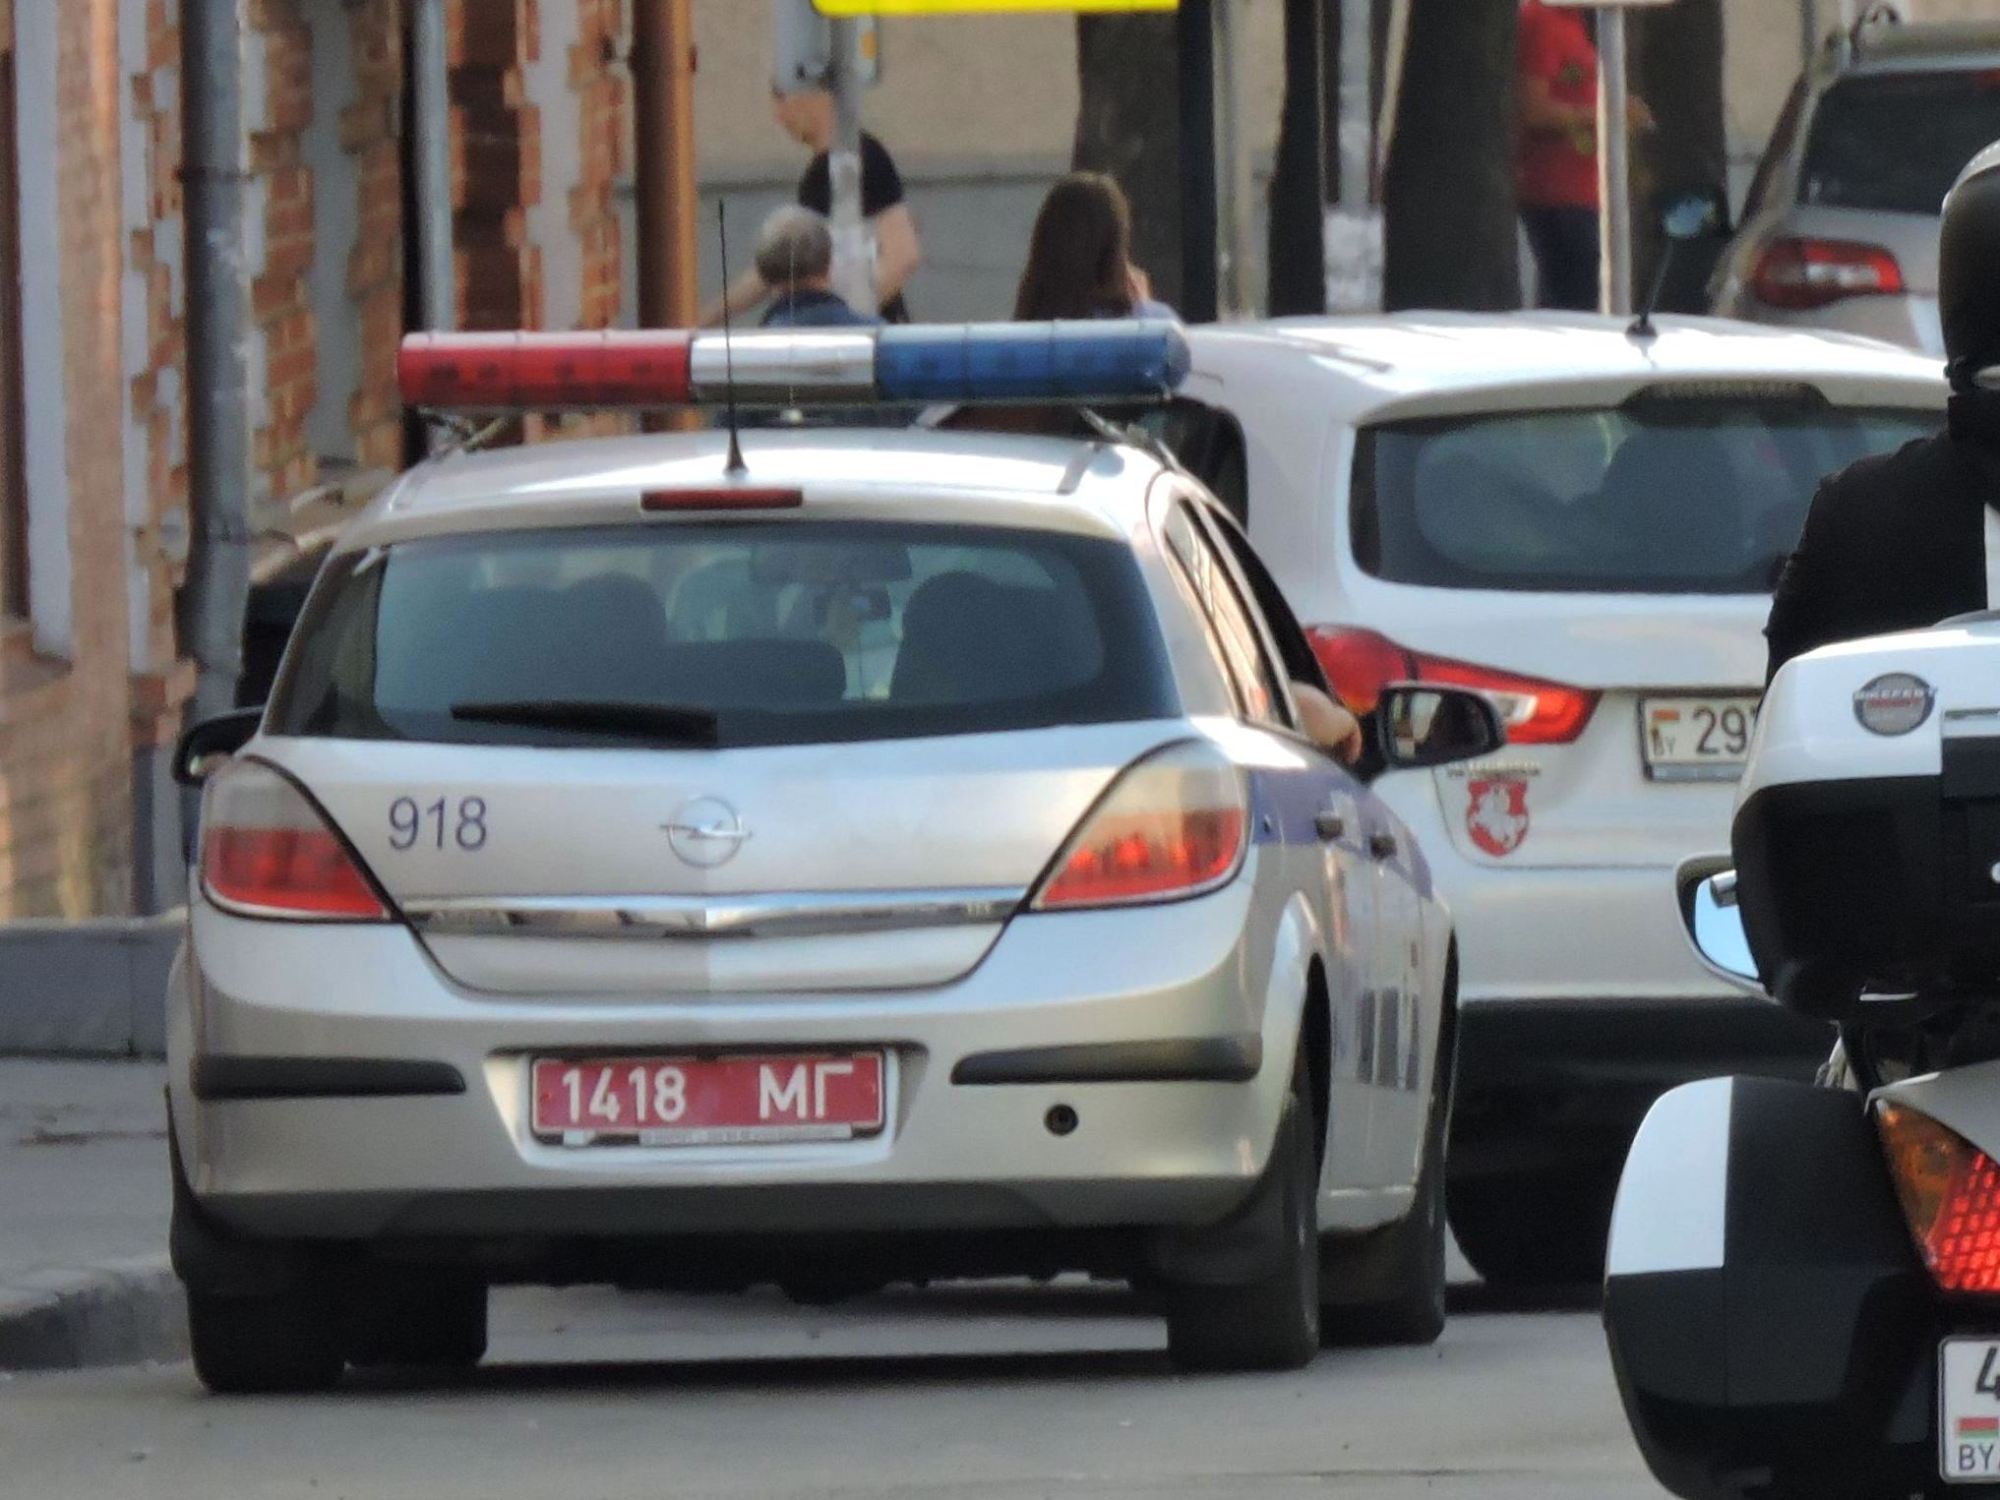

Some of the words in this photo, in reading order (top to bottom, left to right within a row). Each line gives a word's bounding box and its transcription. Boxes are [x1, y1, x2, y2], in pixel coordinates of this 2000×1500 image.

[1693, 705, 1757, 754] 29
[388, 795, 487, 851] 918
[562, 1065, 687, 1123] 1418
[758, 1062, 854, 1120] МГ
[1959, 1444, 1994, 1471] BY
